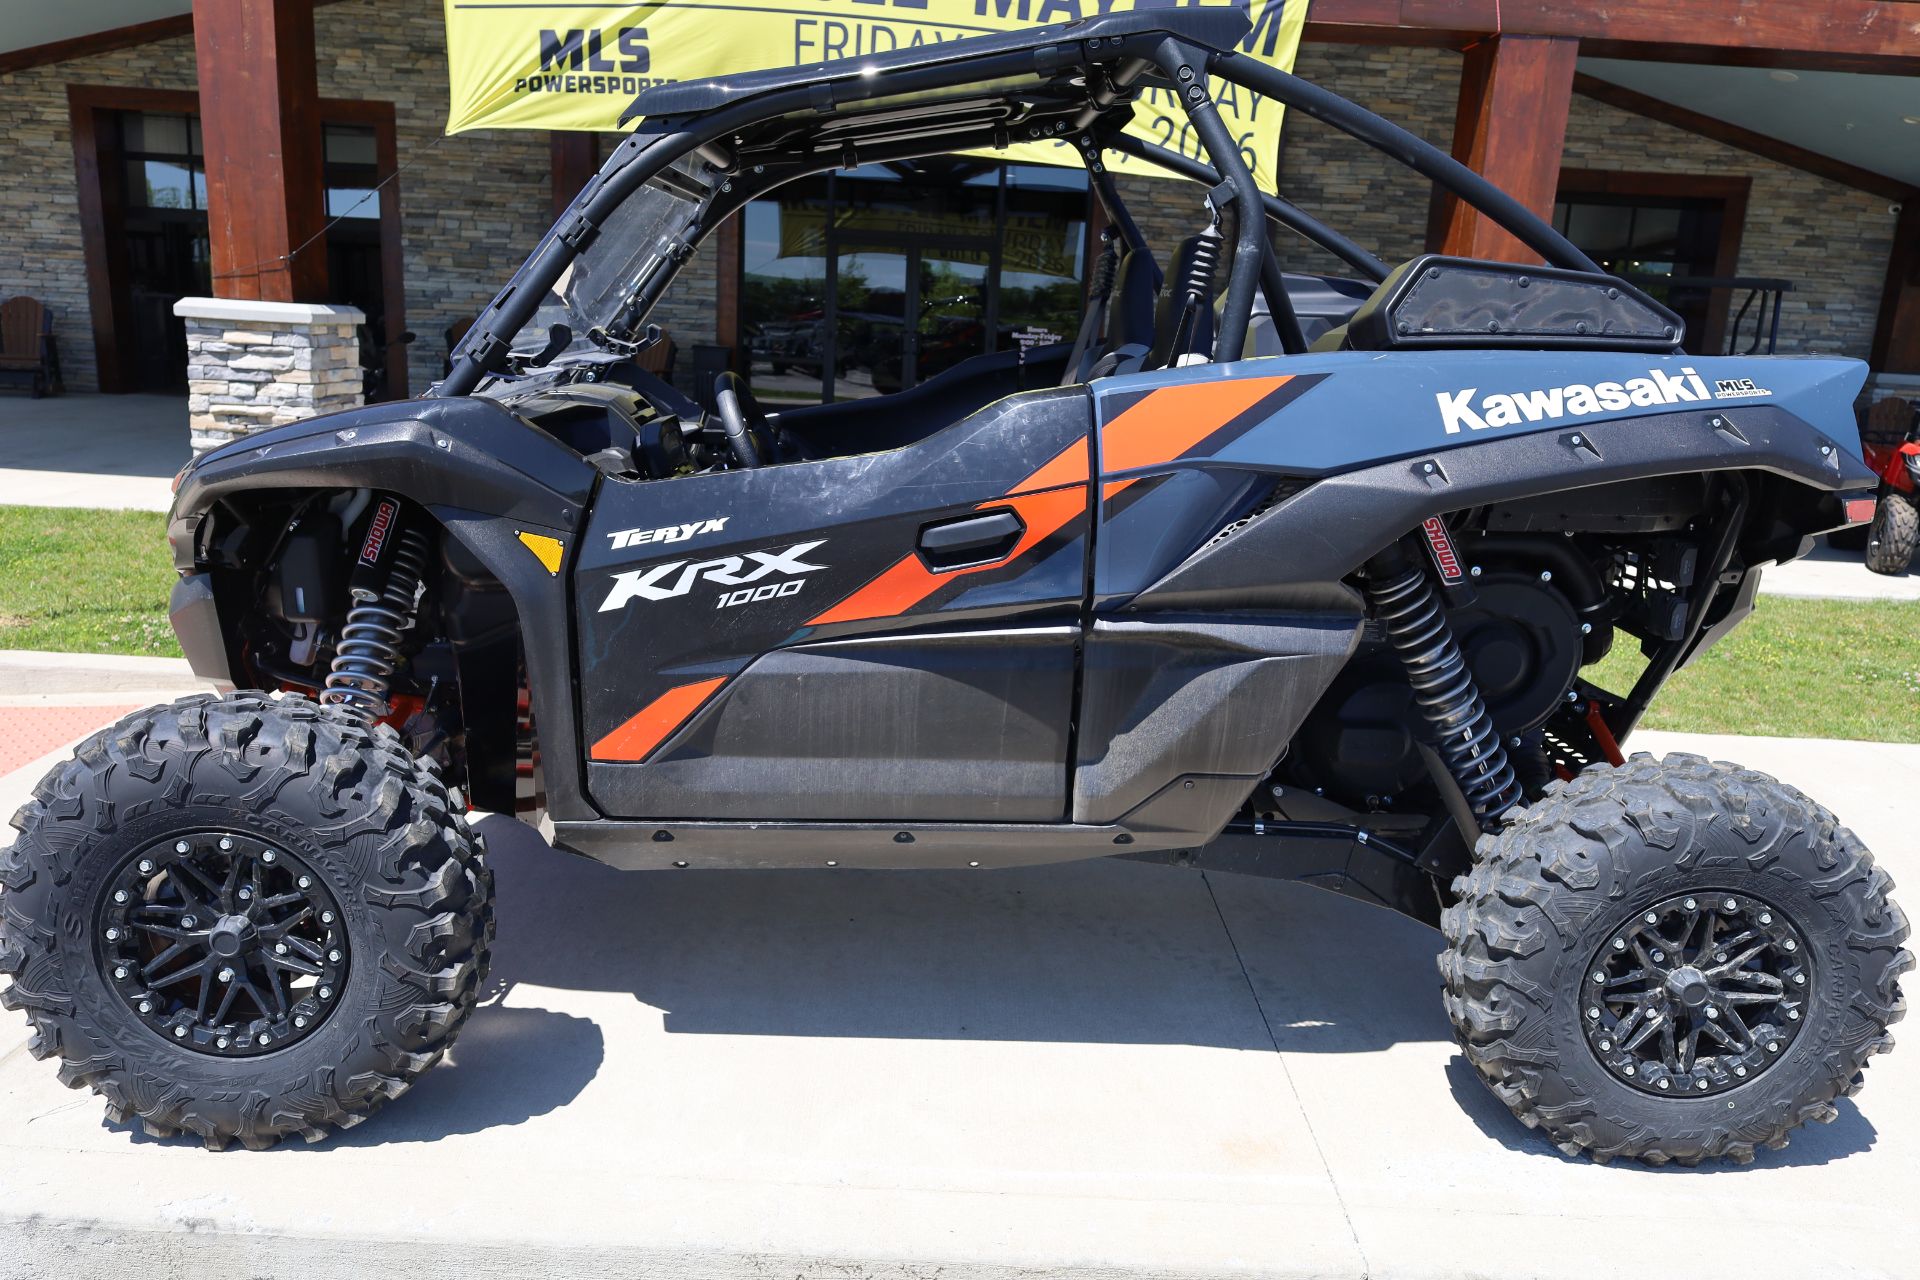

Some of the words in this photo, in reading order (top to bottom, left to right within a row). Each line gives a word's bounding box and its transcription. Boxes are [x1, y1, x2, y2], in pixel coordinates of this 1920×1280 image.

[539, 27, 650, 74] MLS
[795, 18, 963, 66] FRID
[514, 74, 679, 95] POWERSPOR
[1152, 115, 1258, 174] 206
[1436, 367, 1712, 434] Kawasaki
[1717, 379, 1755, 392] MLS
[362, 502, 395, 563] SHOWA
[1422, 517, 1462, 579] SHOWA
[598, 538, 832, 612] KRX
[716, 578, 806, 609] 1000
